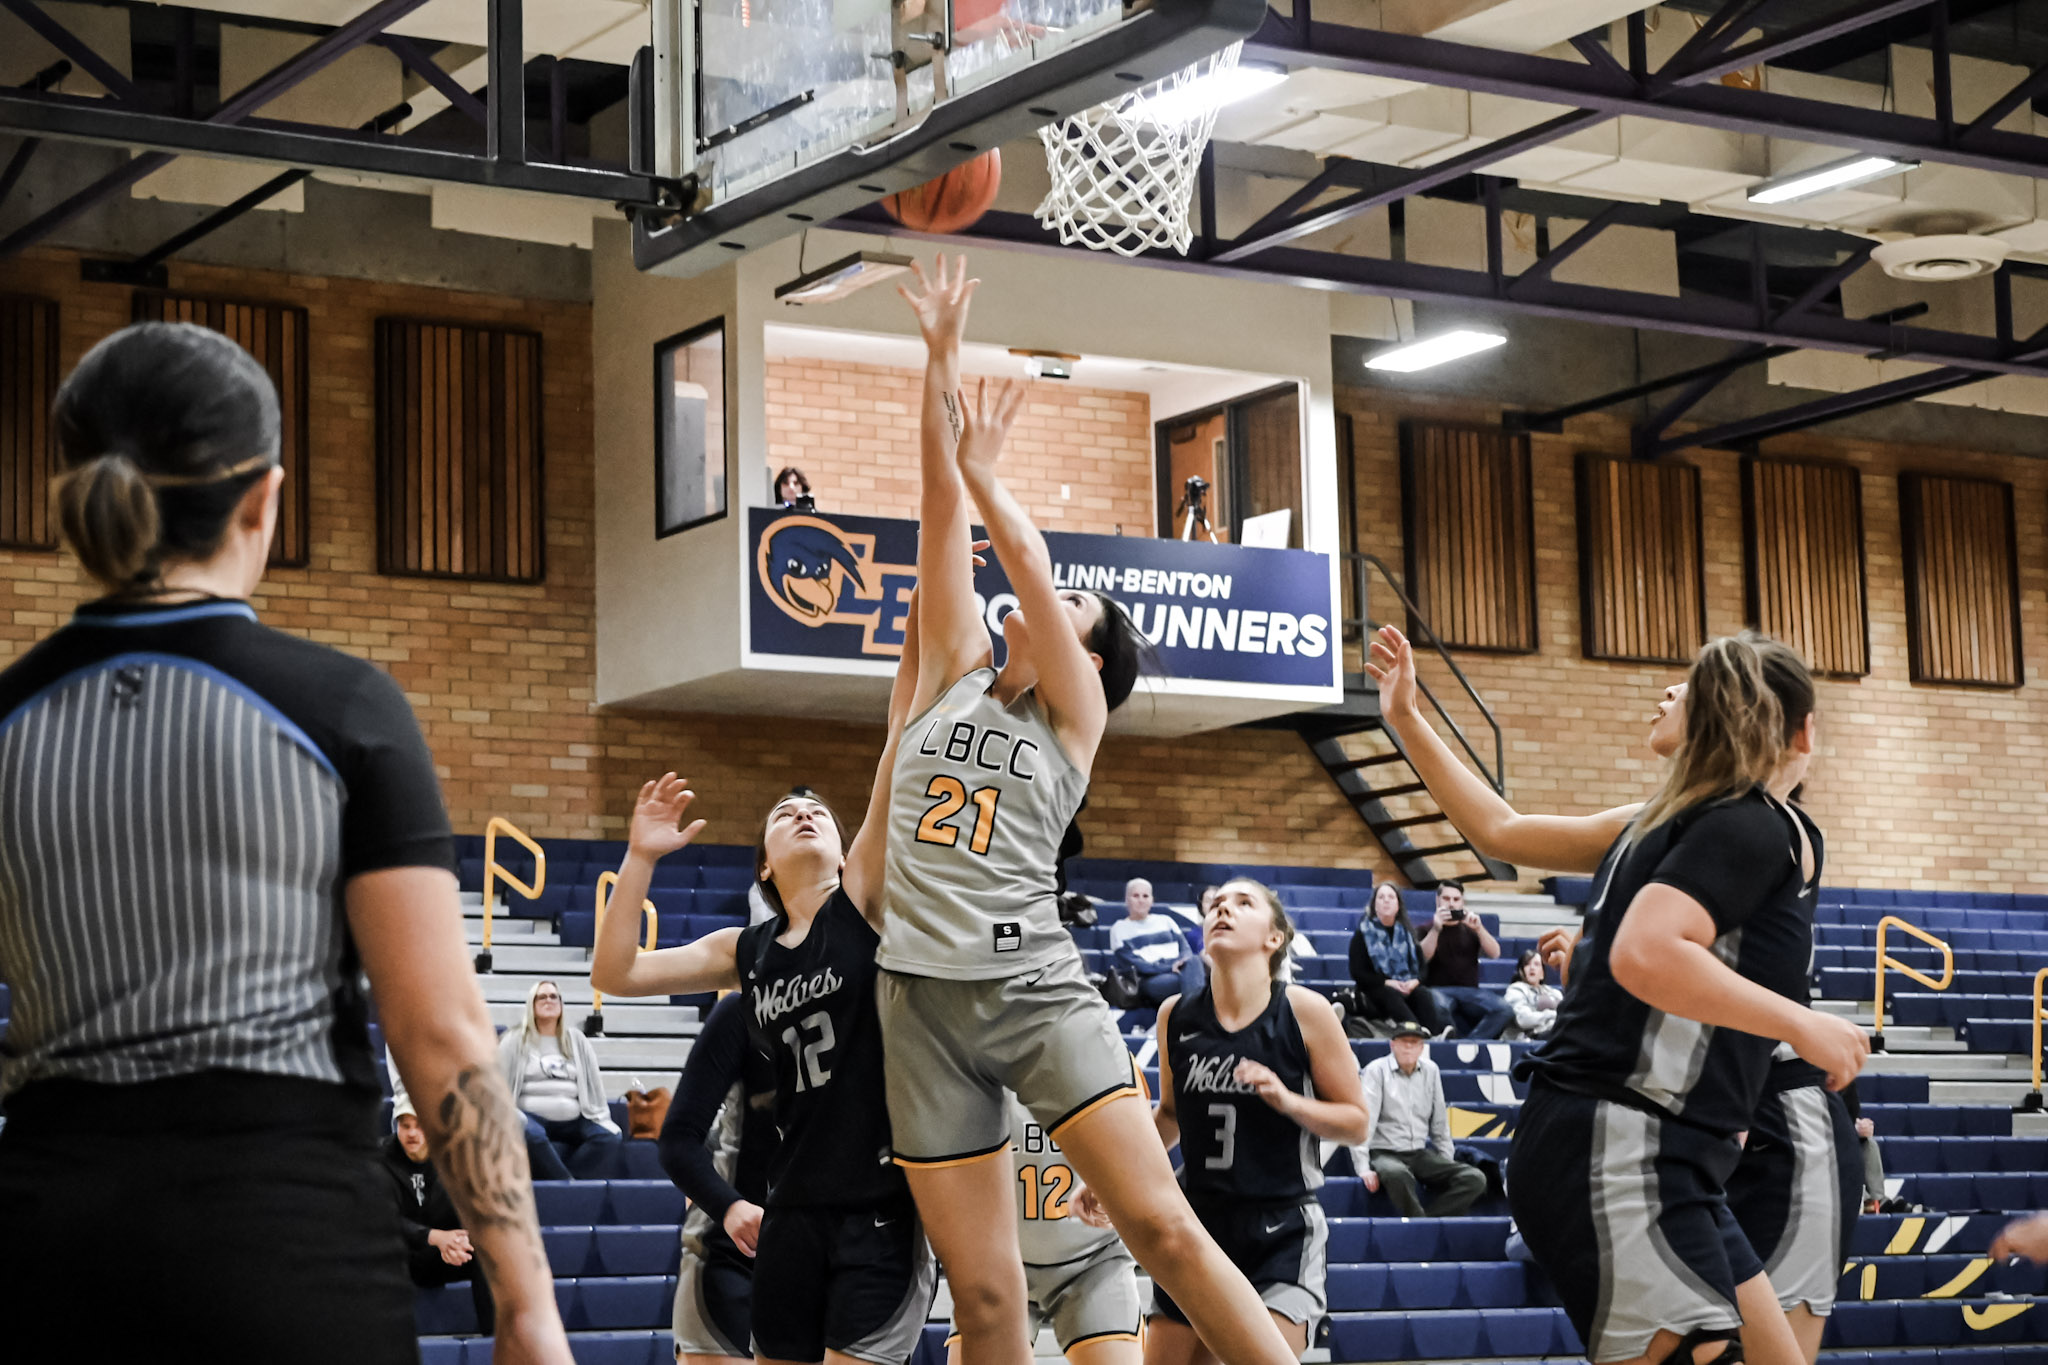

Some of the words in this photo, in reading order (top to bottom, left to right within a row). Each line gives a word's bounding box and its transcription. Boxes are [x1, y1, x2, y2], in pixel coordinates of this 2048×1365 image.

[1053, 562, 1233, 600] LINN-BENTON
[917, 717, 1040, 783] LBCC
[914, 773, 1001, 856] 21
[751, 967, 843, 1029] Wolves
[782, 1011, 836, 1093] 12
[1205, 1103, 1237, 1170] 3
[1018, 1164, 1073, 1220] 12
